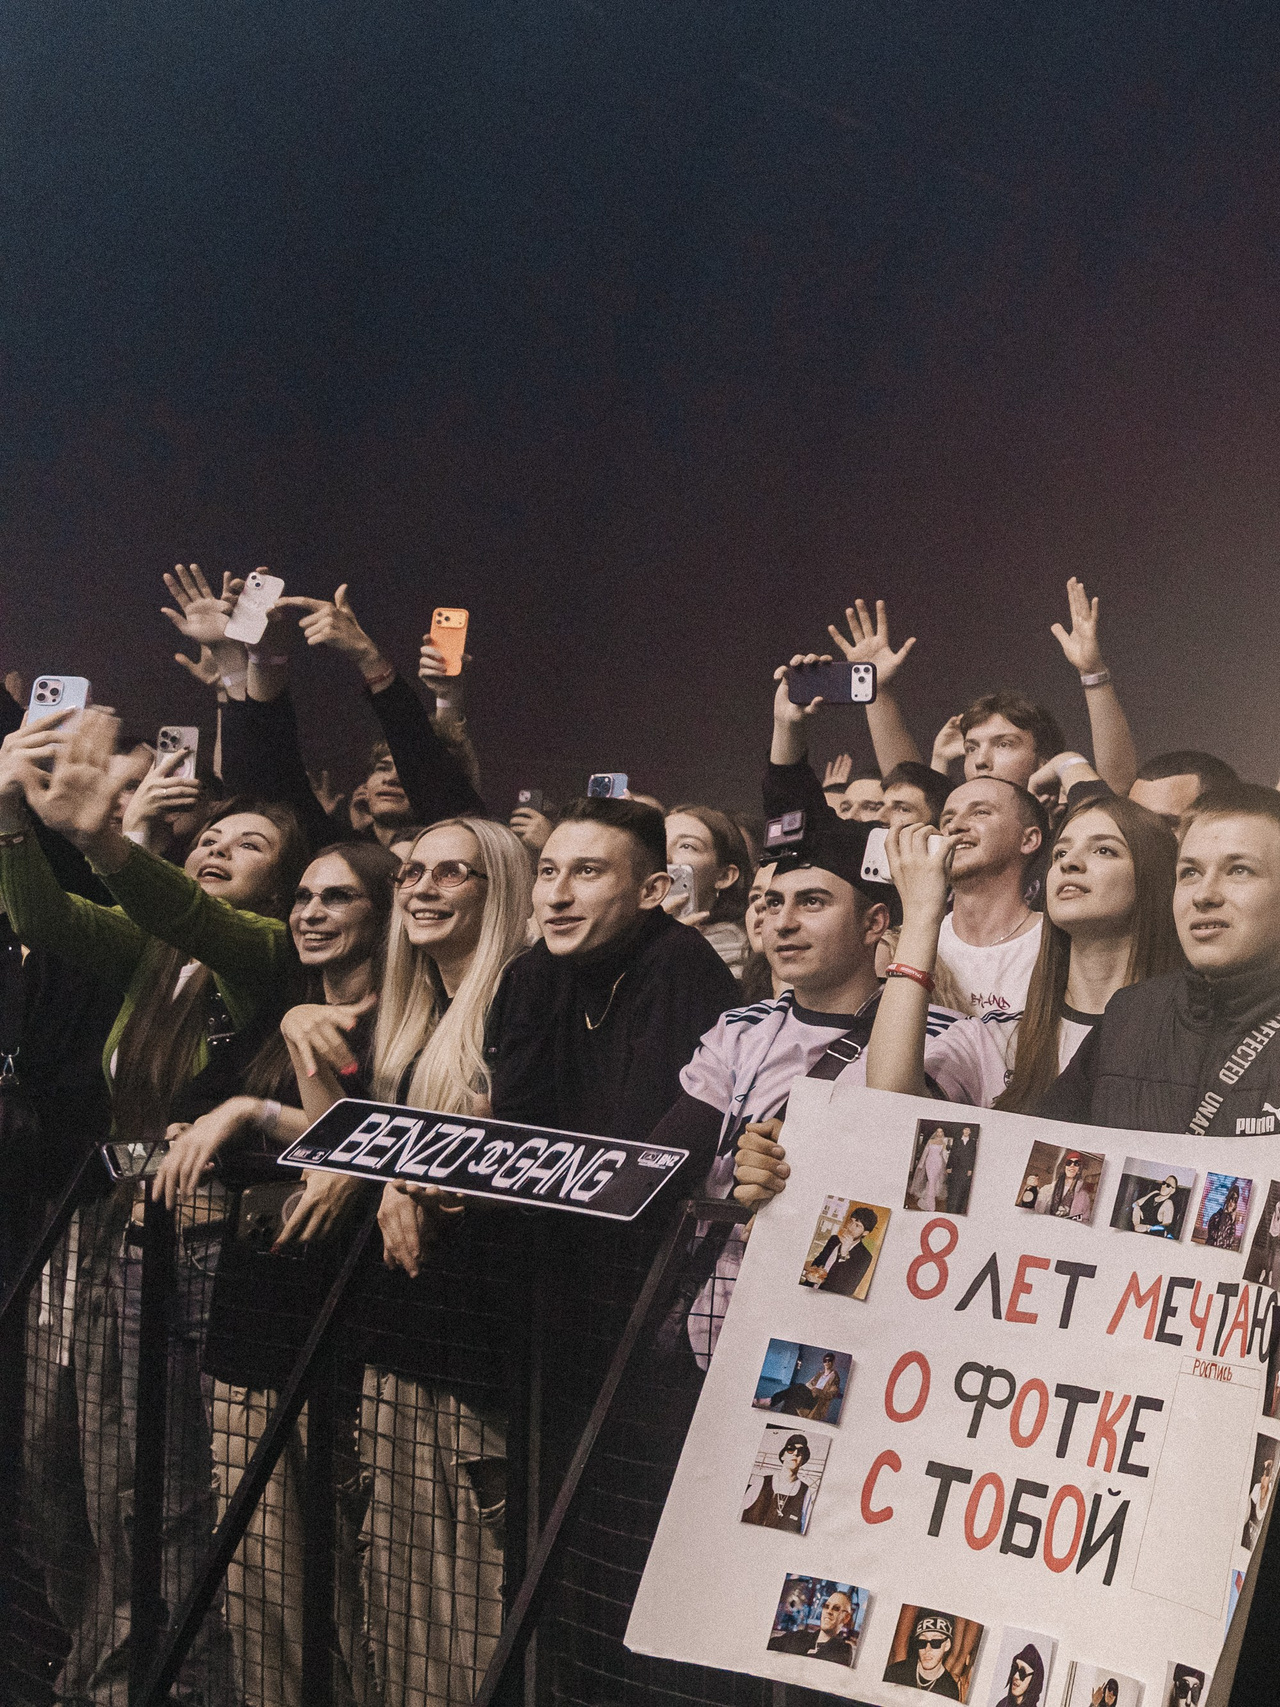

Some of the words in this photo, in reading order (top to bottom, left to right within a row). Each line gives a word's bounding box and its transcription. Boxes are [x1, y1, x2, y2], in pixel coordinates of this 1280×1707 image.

[328, 1113, 486, 1178] BENZO
[491, 1138, 626, 1202] GANG
[1184, 1092, 1224, 1136] UNAF
[1235, 1115, 1275, 1135] PUMA
[906, 1217, 959, 1300] 8
[954, 1252, 1098, 1329] ЛЕТ
[1105, 1270, 1279, 1364] МЕЧТАЮ
[884, 1350, 931, 1423] О
[954, 1361, 1165, 1478] ФОТКЕ
[860, 1449, 902, 1525] С
[924, 1460, 1131, 1587] ТОБОЙ
